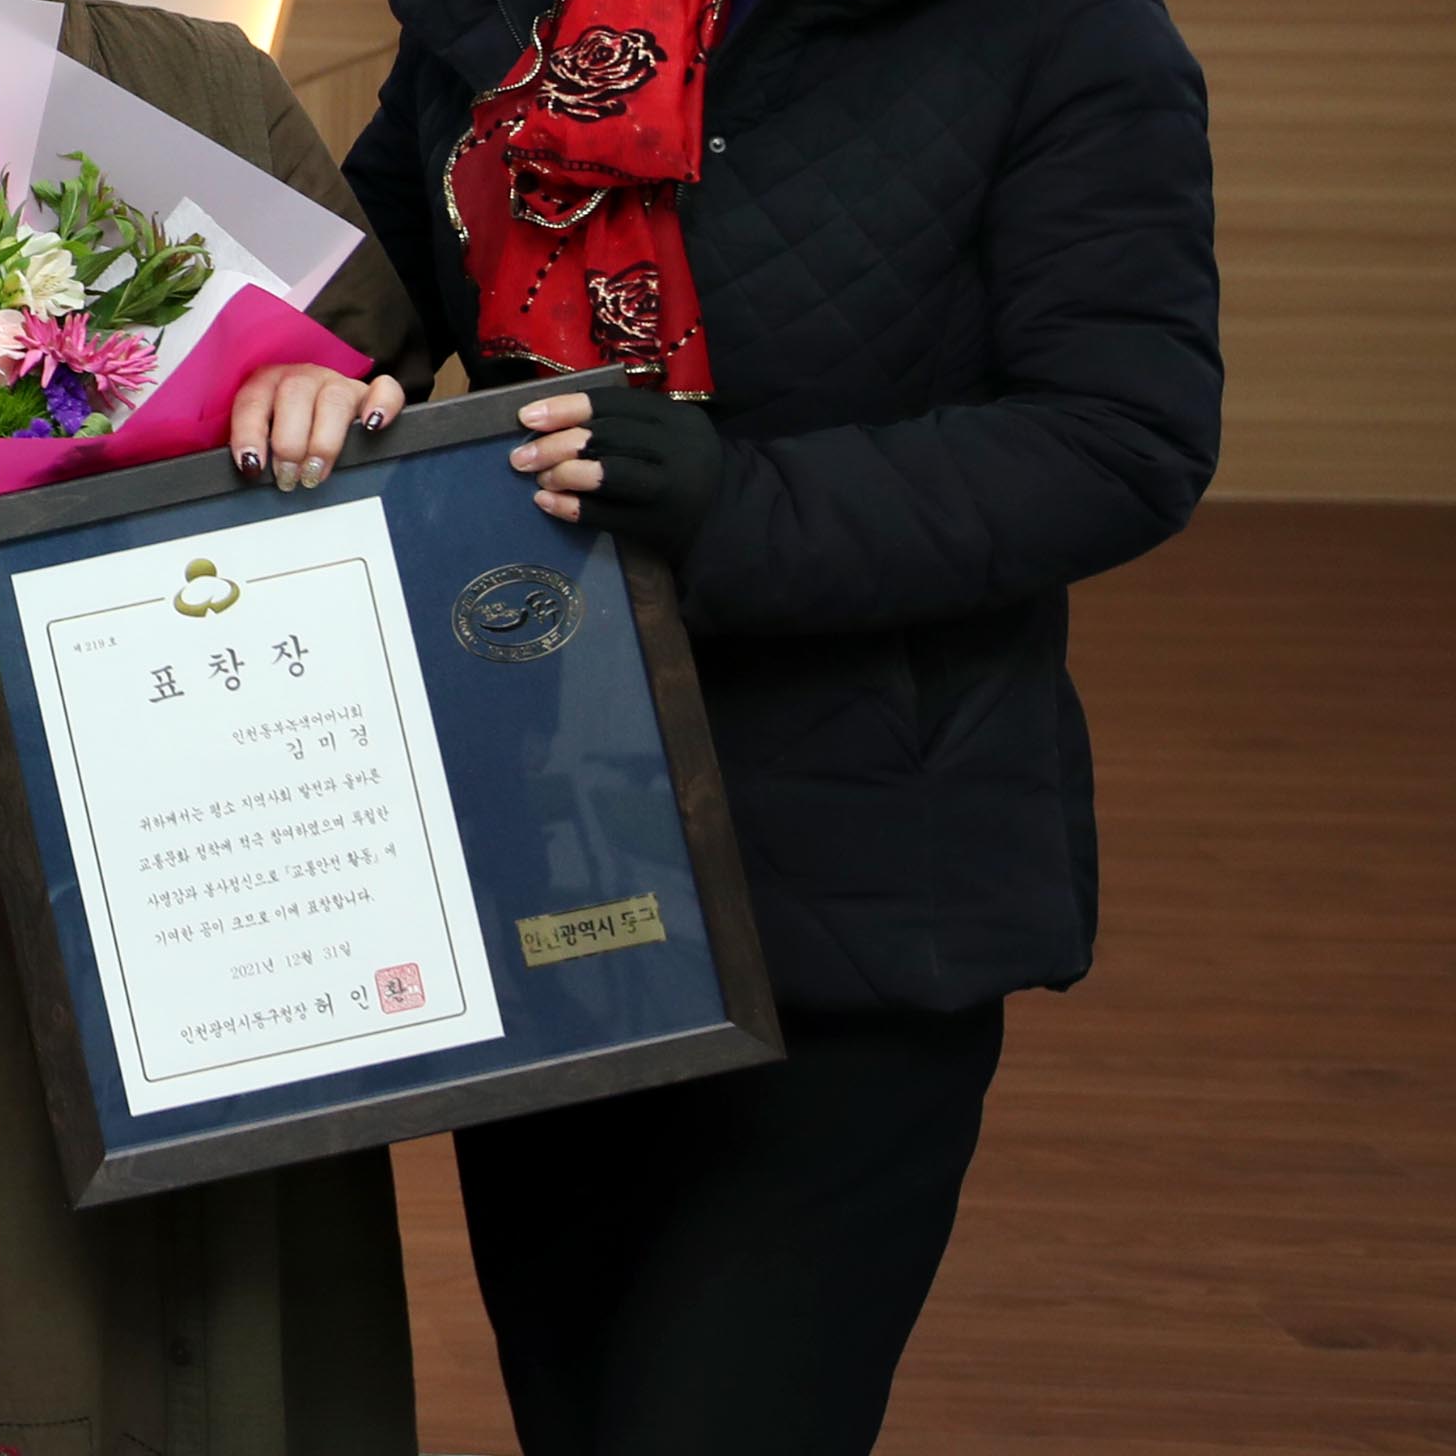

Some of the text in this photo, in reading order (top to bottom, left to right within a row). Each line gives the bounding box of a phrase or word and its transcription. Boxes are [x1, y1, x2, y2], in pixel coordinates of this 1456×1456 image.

[149, 634, 309, 703] 표 창 장
[230, 941, 352, 980] 2021년 12월 31일
[180, 1002, 308, 1045] 인천광역시동구청장
[350, 985, 369, 1011] 인
